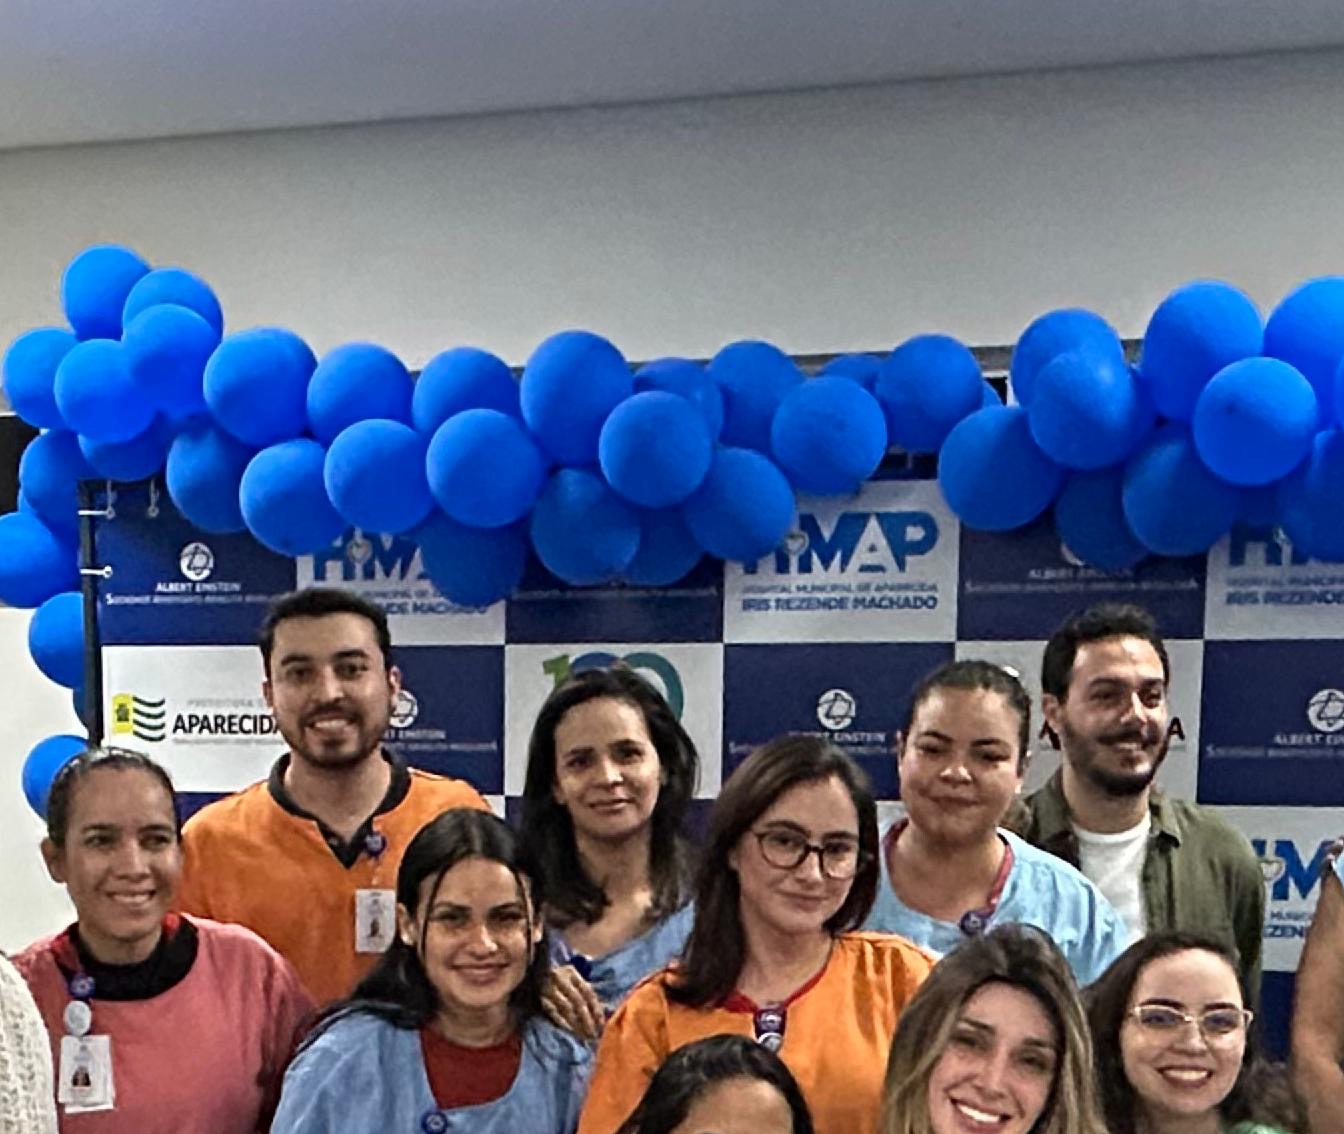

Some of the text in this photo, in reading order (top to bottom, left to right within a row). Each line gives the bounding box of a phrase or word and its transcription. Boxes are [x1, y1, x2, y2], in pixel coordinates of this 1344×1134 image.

[775, 596, 849, 611] REZENDE
[853, 595, 938, 610] MACHADO
[1273, 734, 1322, 746] ALBERT
